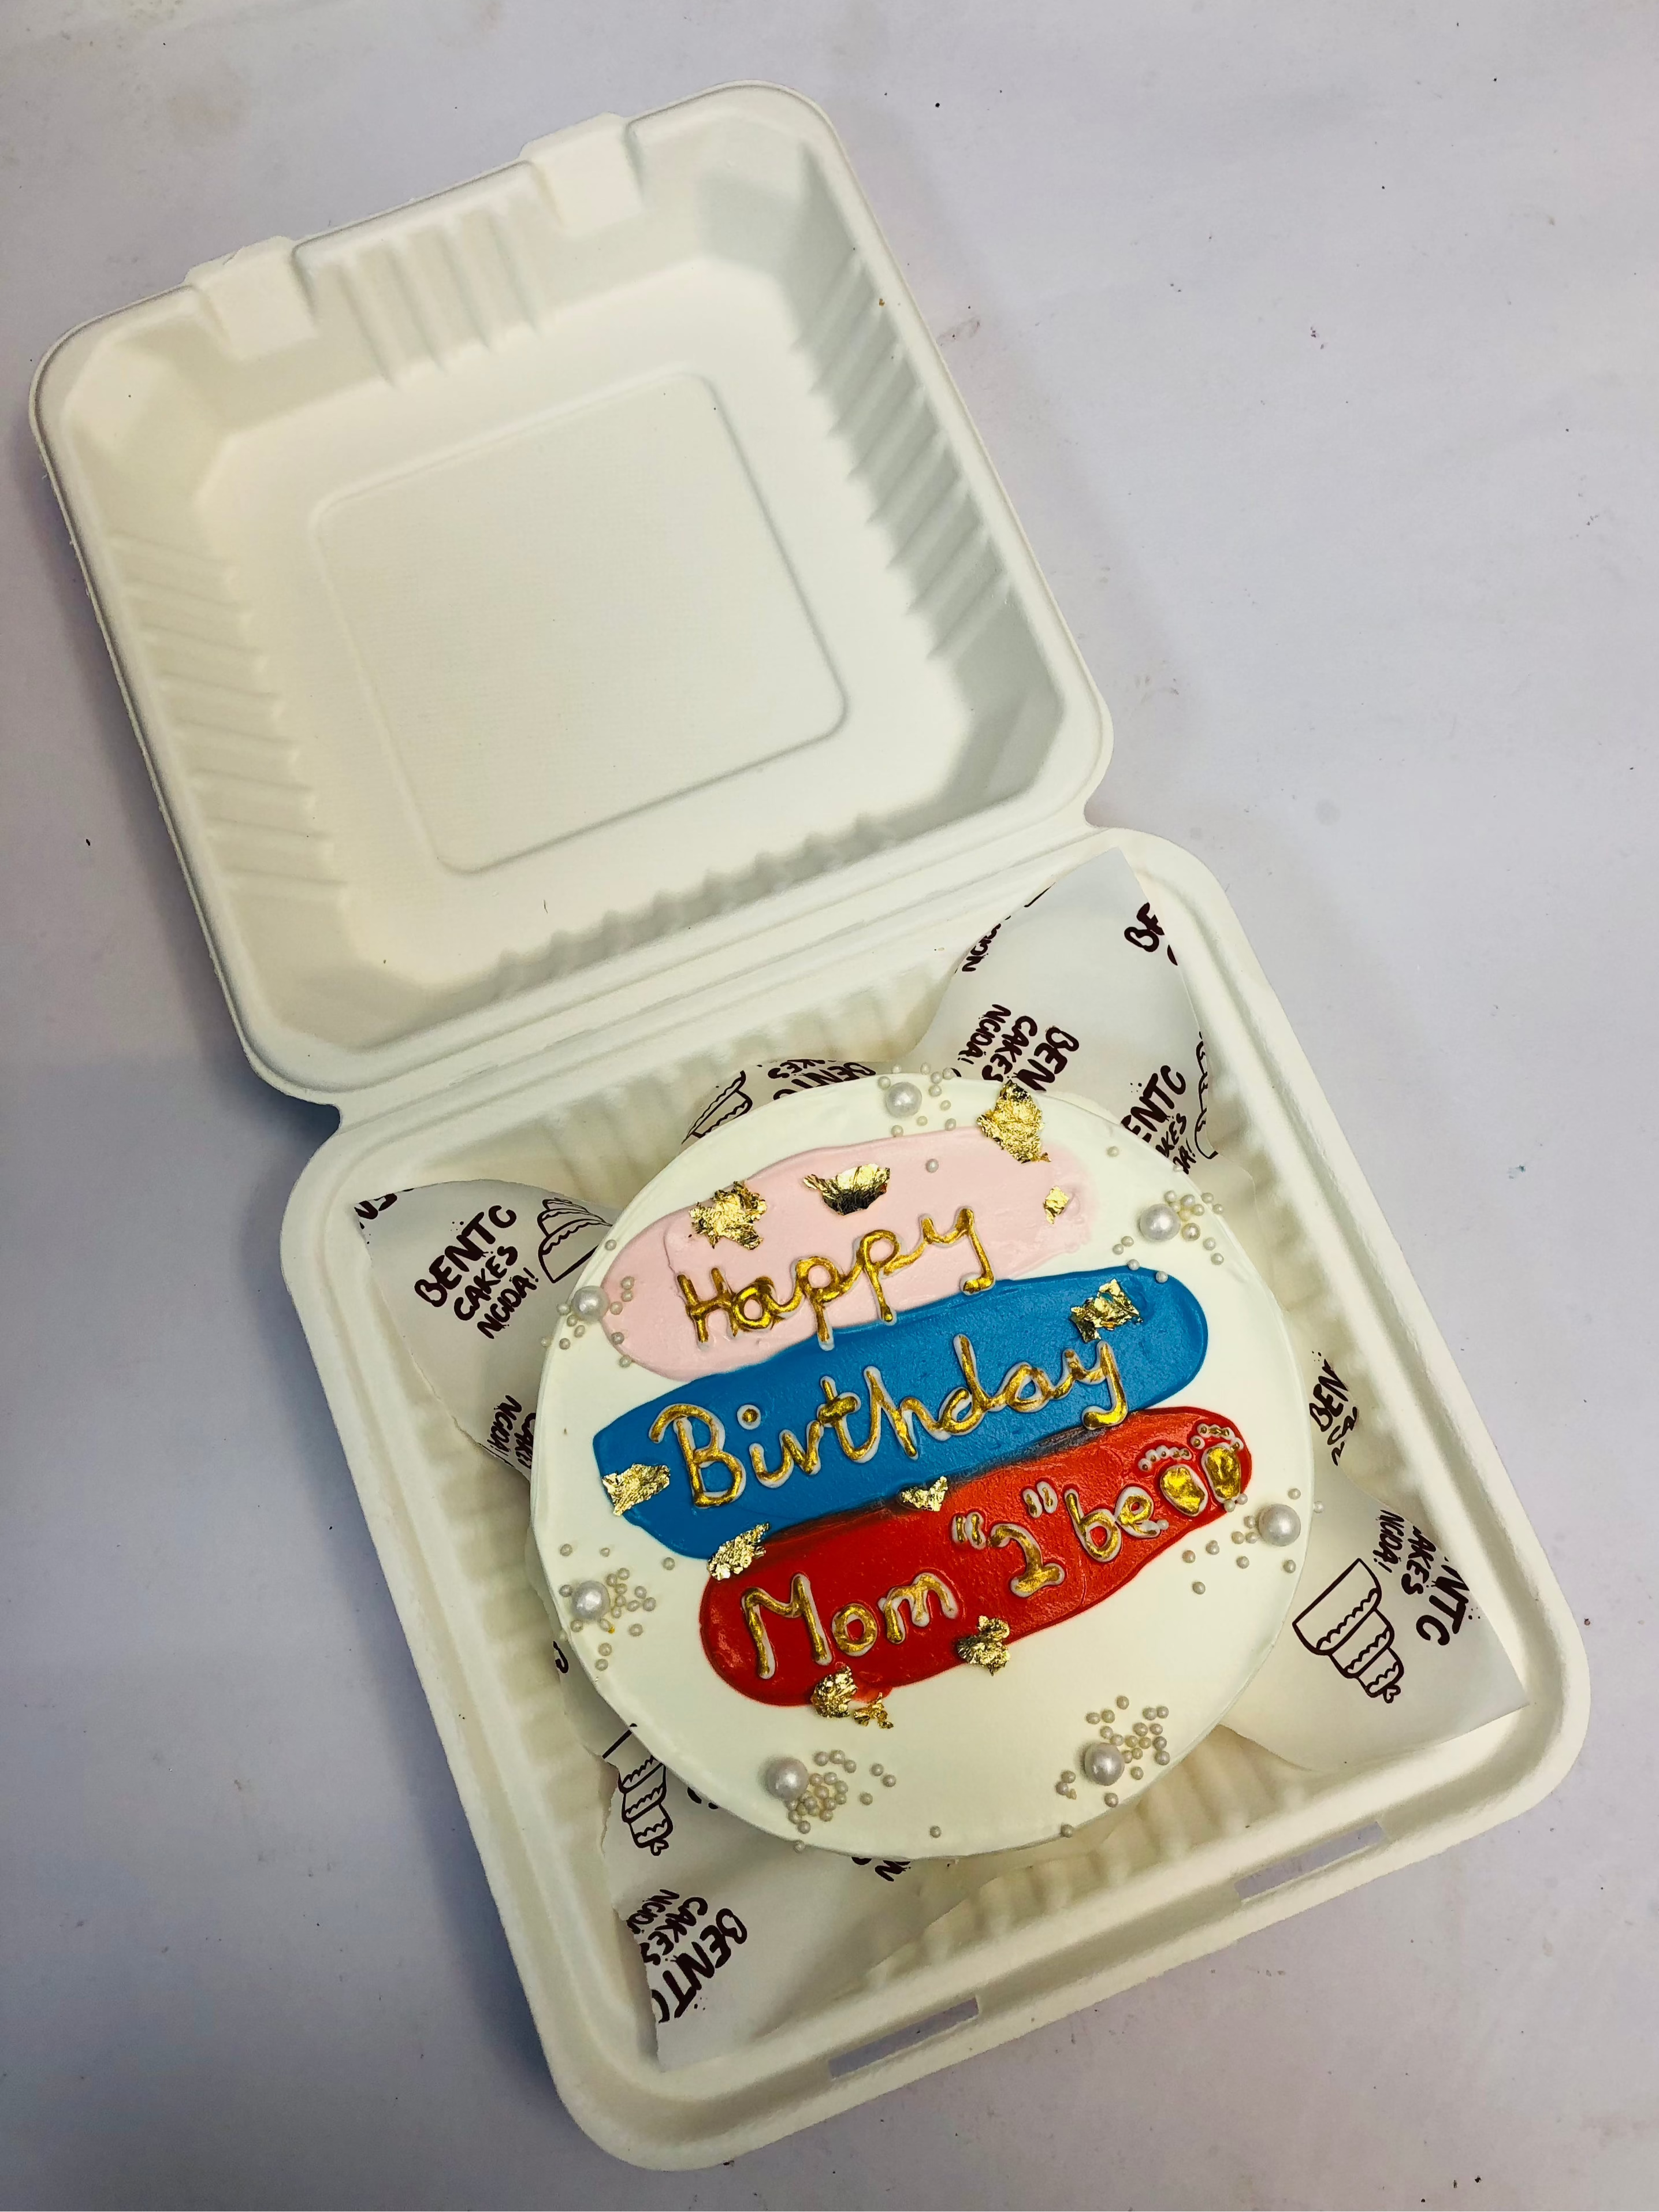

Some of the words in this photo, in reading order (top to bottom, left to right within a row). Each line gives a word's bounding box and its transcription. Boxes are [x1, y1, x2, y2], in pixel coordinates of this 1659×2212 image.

[981, 1015, 1038, 1082] CAKES
[1014, 1025, 1080, 1092] BEN
[453, 1246, 518, 1321] CAKES
[676, 1207, 996, 1350] Happy
[648, 1334, 1130, 1509] Birthday
[1309, 1358, 1349, 1432] BEN
[741, 1572, 959, 1680] Mom
[1063, 1485, 1161, 1563] be
[1401, 1525, 1437, 1595] AKES
[639, 1897, 708, 1966] CAKES
